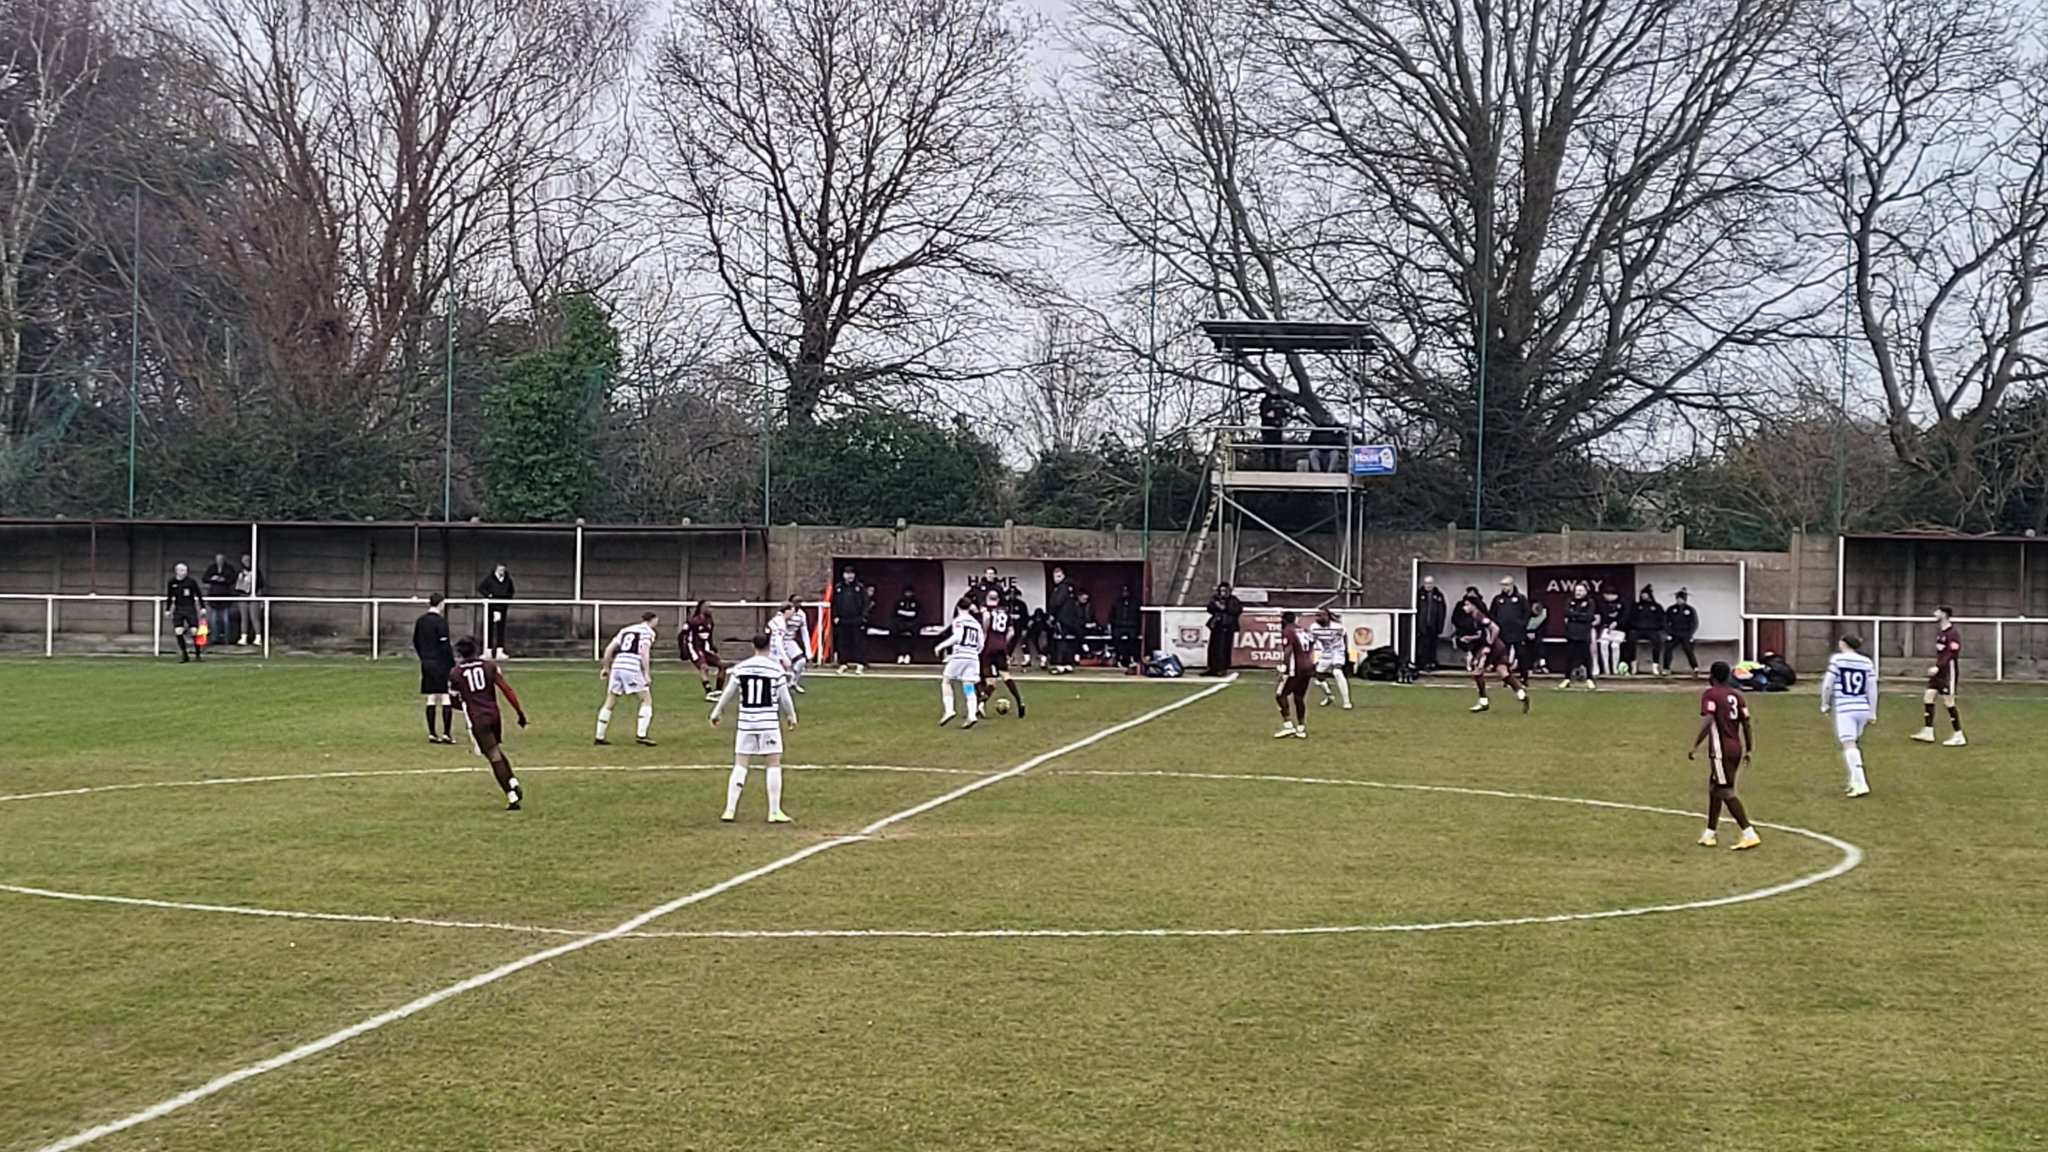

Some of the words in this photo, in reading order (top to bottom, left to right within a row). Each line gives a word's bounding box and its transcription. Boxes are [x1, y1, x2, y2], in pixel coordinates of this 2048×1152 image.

[991, 609, 1008, 632] 18
[621, 632, 635, 651] 8
[463, 667, 486, 692] 10
[747, 678, 763, 704] 11
[1844, 671, 1864, 694] 19
[1727, 694, 1738, 720] 3
